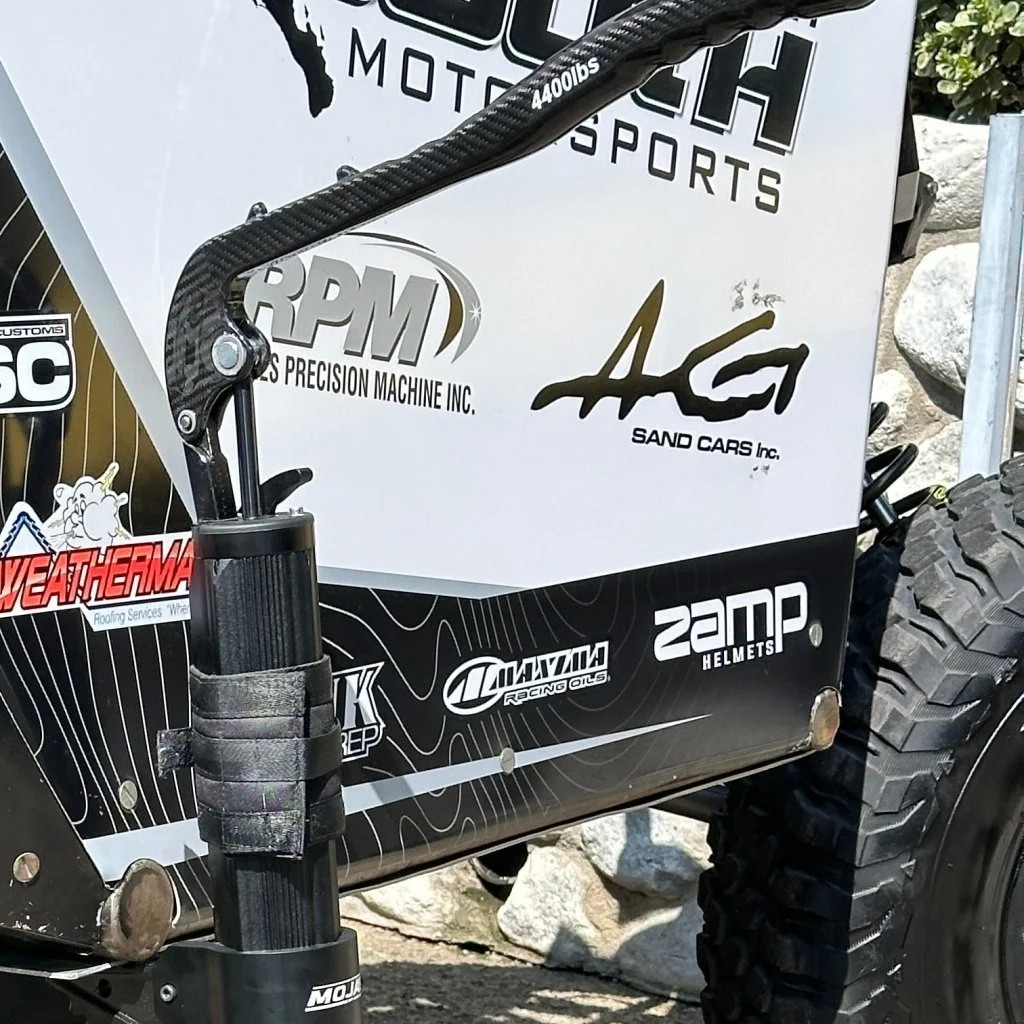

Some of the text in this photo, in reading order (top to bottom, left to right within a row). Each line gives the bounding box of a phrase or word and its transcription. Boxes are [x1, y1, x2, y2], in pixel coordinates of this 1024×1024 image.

[530, 56, 600, 110] 4400lbs
[244, 254, 439, 367] RPM
[285, 355, 369, 398] PRECISION
[373, 369, 443, 410] MACHINE
[446, 382, 476, 416] INC.
[631, 427, 780, 460] SAND CARS Inc.
[93, 610, 126, 626] Roofing
[127, 606, 163, 622] Services
[654, 581, 808, 662] zamp
[702, 639, 775, 670] HELMETS
[504, 671, 607, 705] RACING OILS
